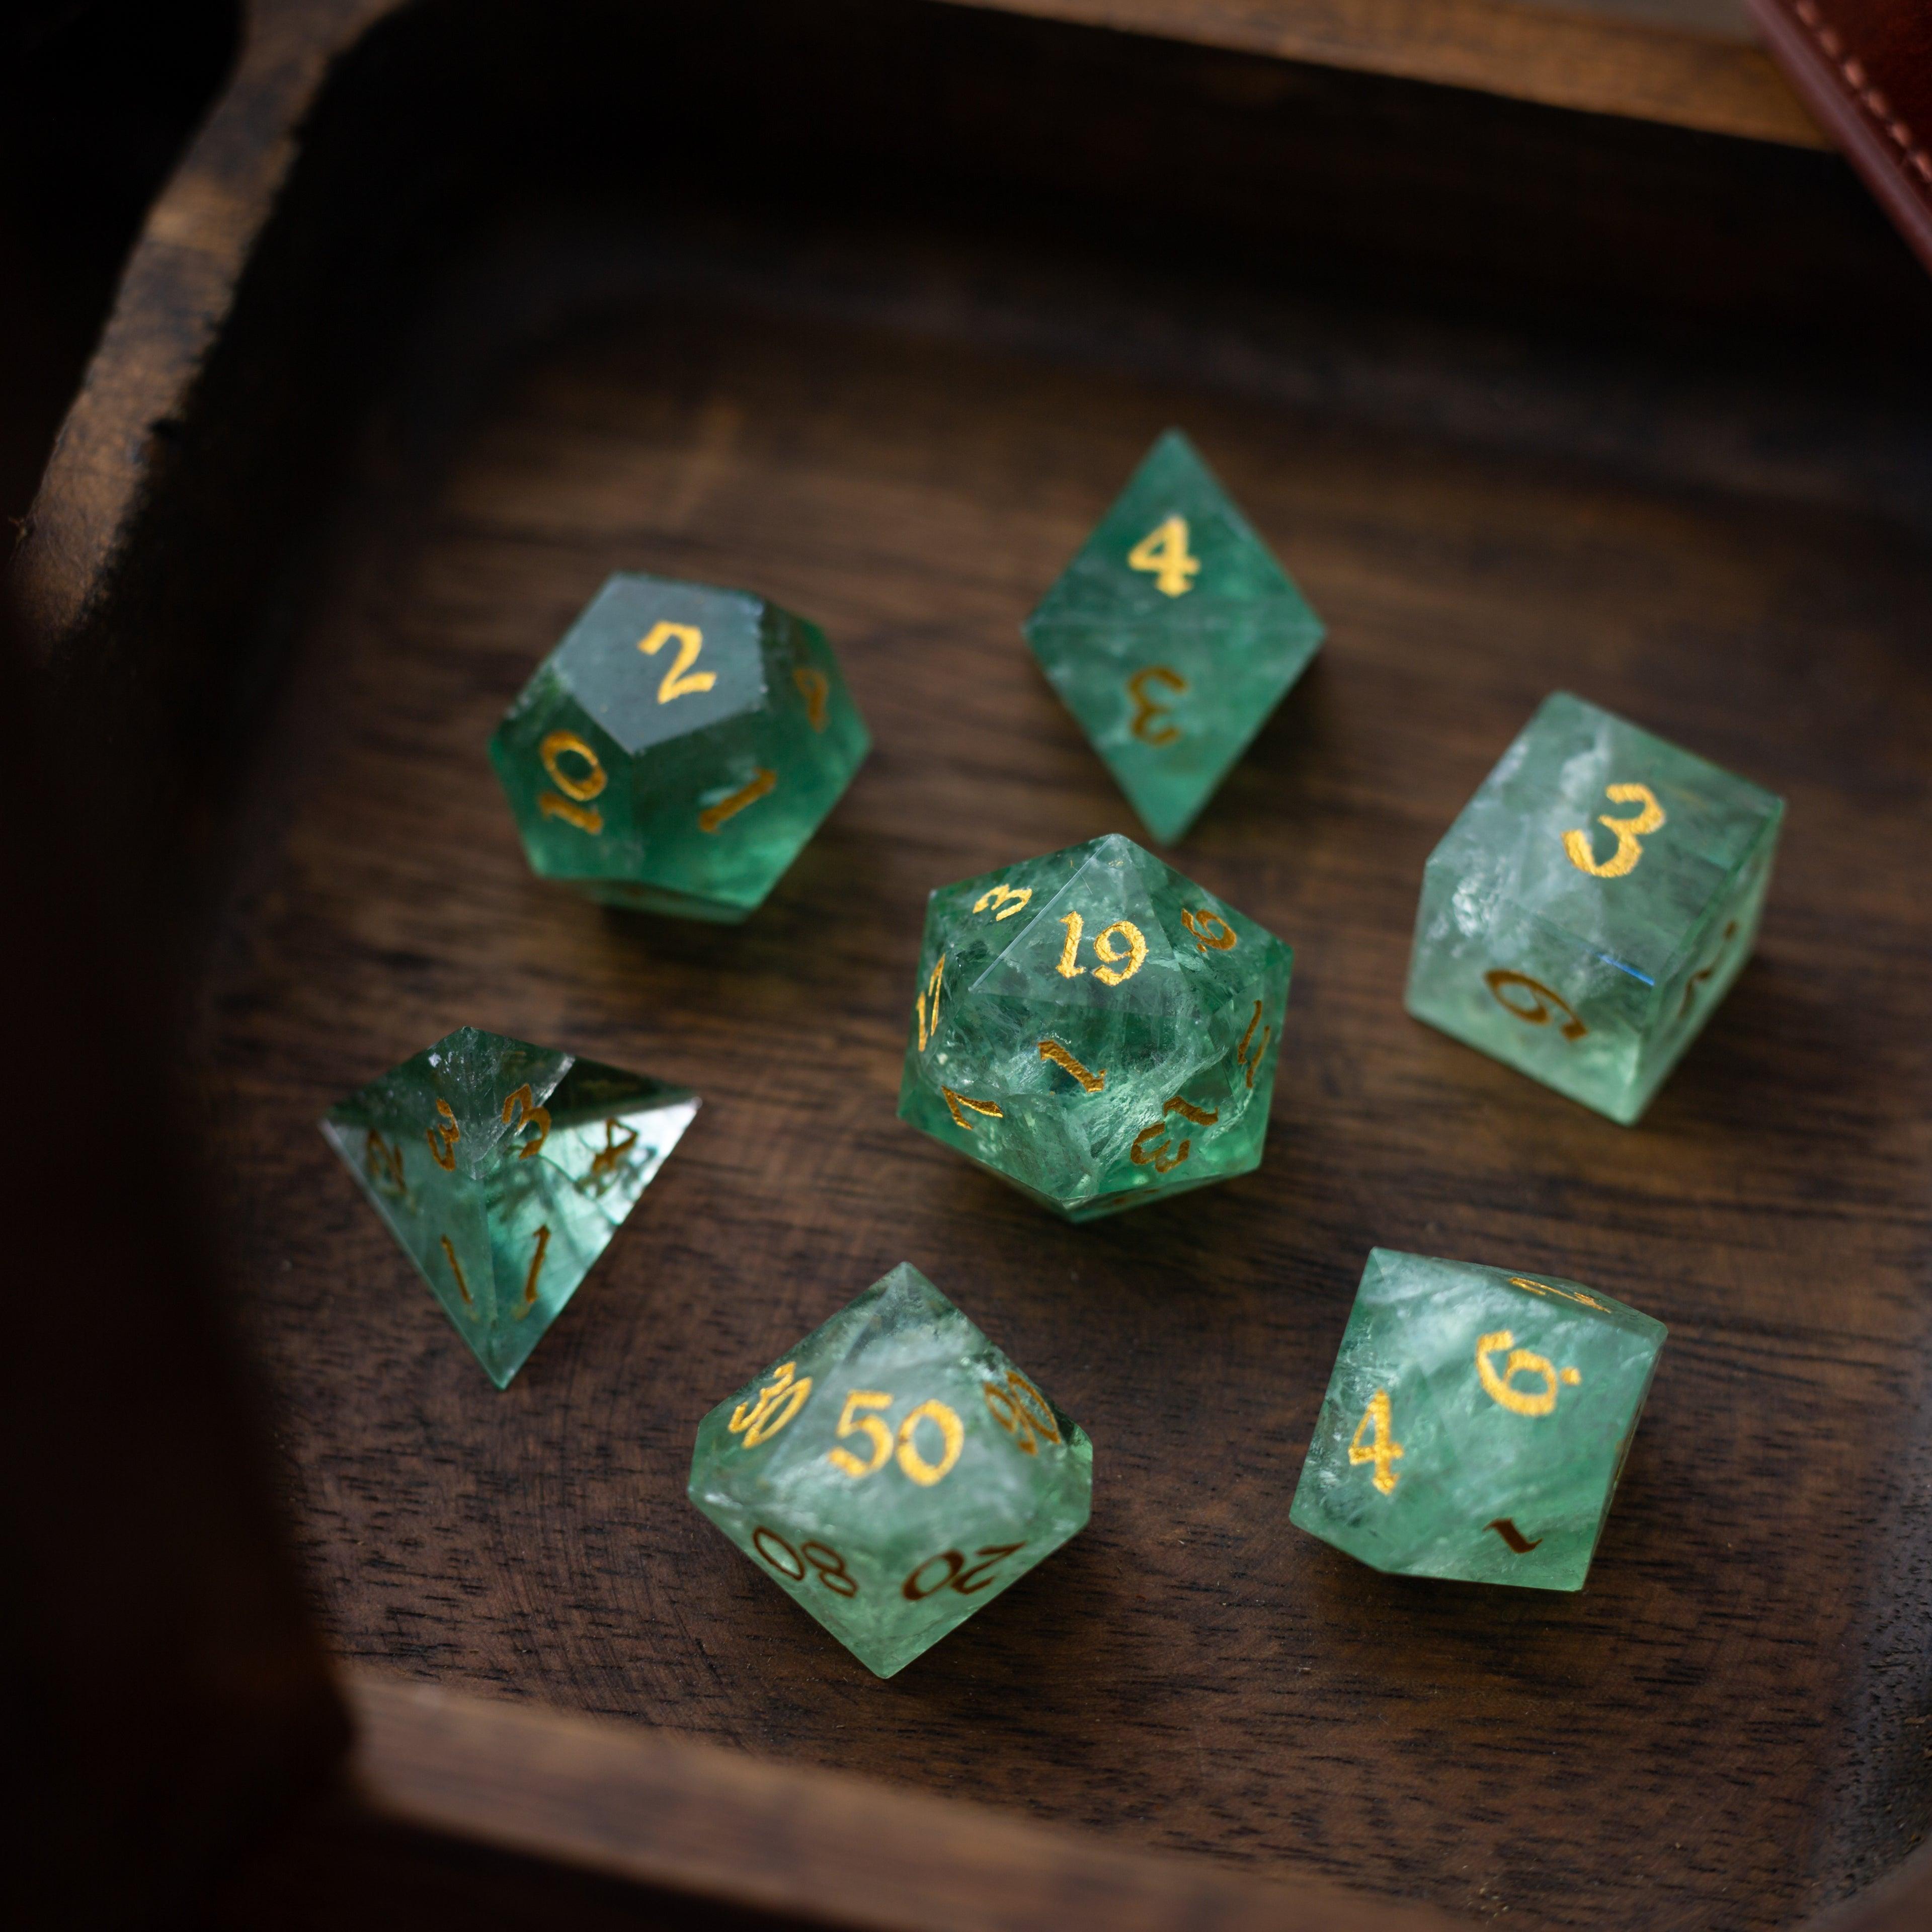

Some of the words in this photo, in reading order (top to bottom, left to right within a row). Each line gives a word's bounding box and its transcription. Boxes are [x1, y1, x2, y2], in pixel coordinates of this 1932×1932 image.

[1128, 515, 1201, 598] 4
[637, 620, 718, 704] 2
[1125, 665, 1188, 748] 3
[537, 730, 608, 836] 10
[699, 767, 777, 834] 1
[1560, 783, 1666, 878] 3
[973, 884, 1032, 921] 3
[1056, 911, 1149, 987] 19
[1038, 1039, 1106, 1093] 1
[502, 1083, 551, 1160] 3
[524, 1224, 551, 1304] 1
[729, 1361, 813, 1449] 30
[828, 1390, 964, 1487] 50
[1348, 1388, 1404, 1496] 4
[752, 1526, 859, 1598] 80
[902, 1542, 1027, 1601] 20
